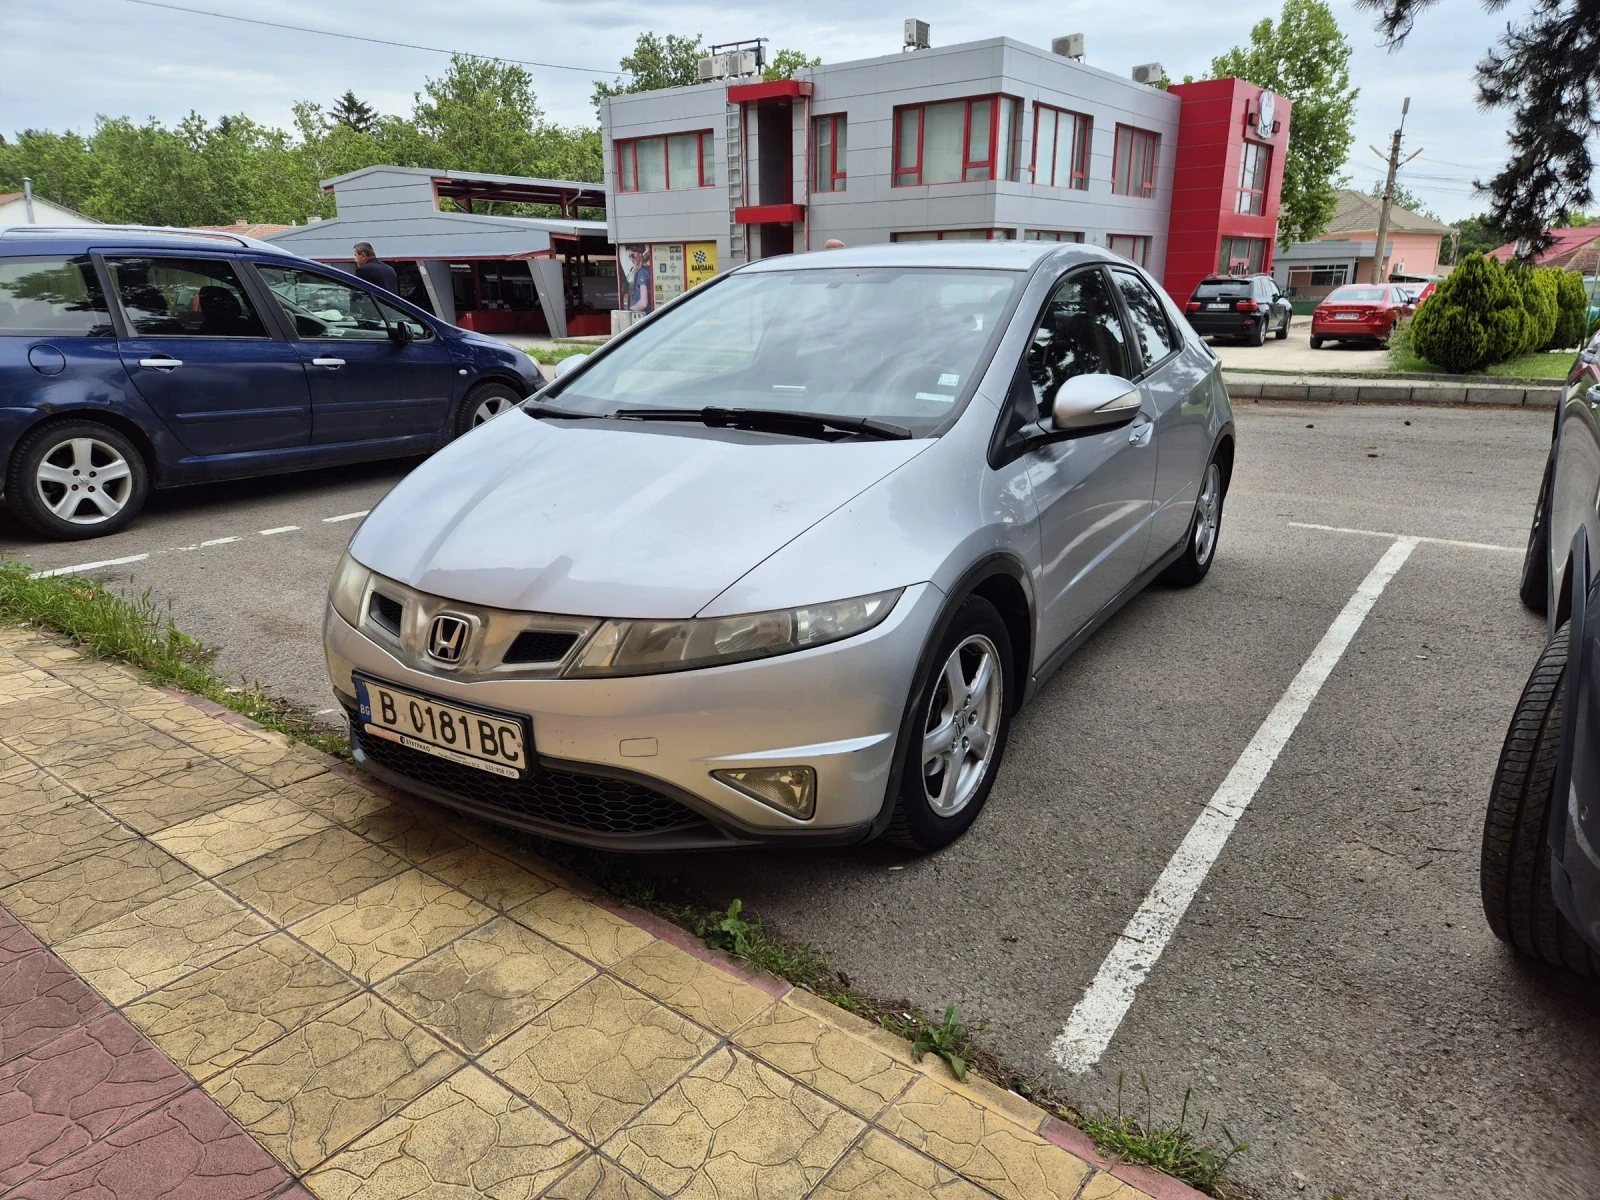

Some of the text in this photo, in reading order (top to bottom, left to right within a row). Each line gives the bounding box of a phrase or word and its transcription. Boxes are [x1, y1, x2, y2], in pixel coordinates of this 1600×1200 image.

[691, 264, 715, 272] BARDAHL
[360, 703, 370, 716] BG
[378, 690, 397, 725] B
[409, 700, 472, 750] 0181
[477, 719, 519, 762] BC
